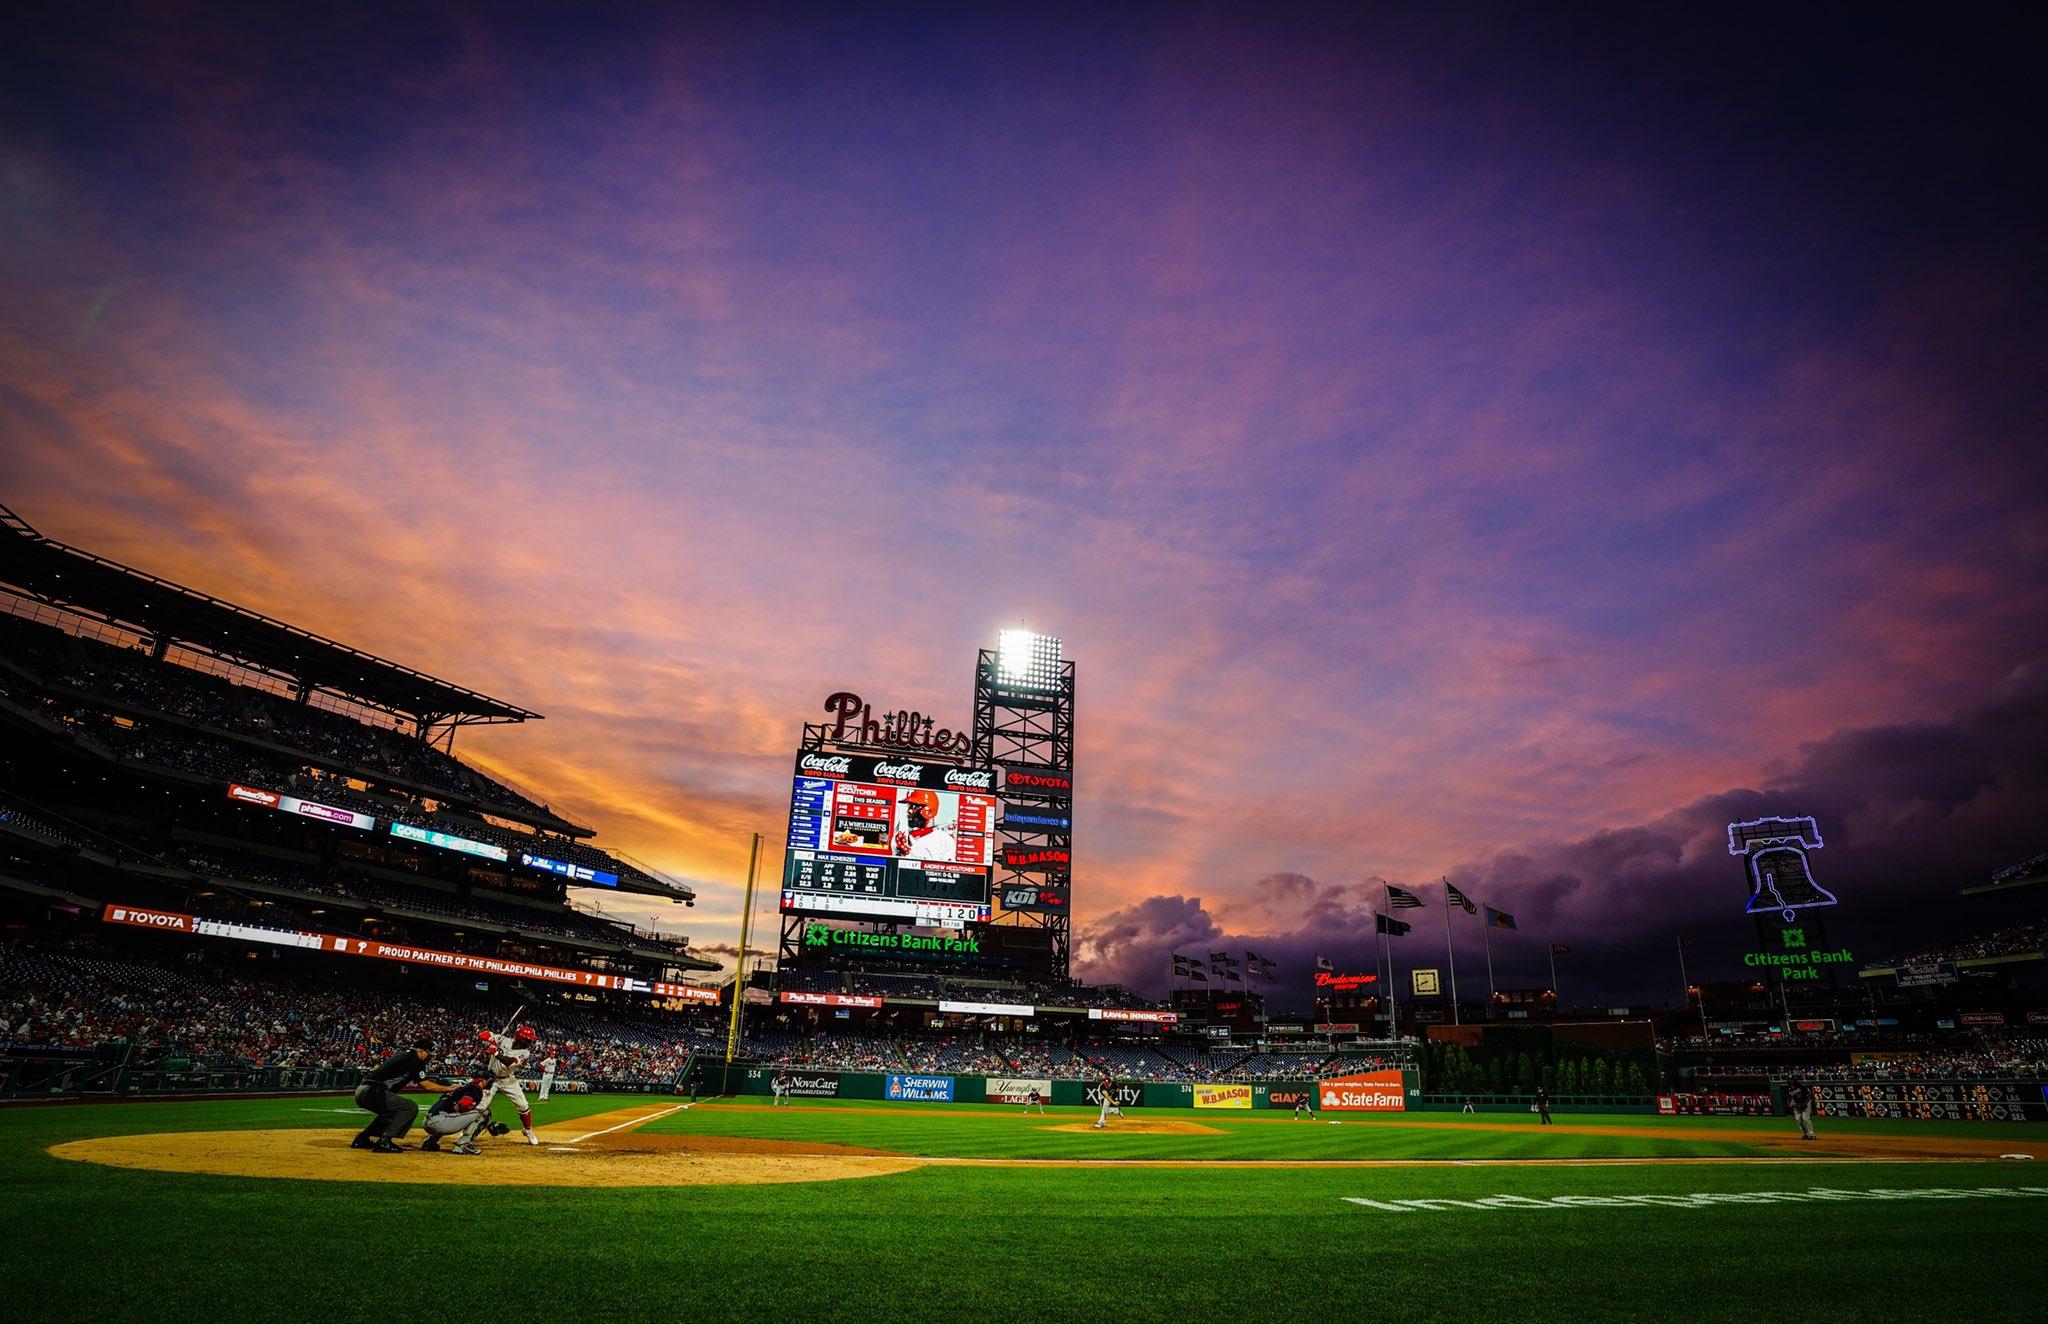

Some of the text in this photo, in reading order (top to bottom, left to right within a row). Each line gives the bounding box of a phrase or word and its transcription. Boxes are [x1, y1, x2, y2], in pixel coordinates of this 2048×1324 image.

[825, 692, 972, 756] Phillies
[1023, 775, 1070, 788] TOYOTA
[300, 803, 352, 823] phillies.com
[1004, 812, 1060, 826] Independence
[397, 824, 426, 840] GOYA
[830, 855, 856, 863] SCHERZER
[1007, 851, 1069, 866] W.B.MASON
[128, 910, 185, 928] TOYOTA
[947, 908, 976, 919] 1 2 0
[832, 929, 980, 953] Citizens Bank Park
[377, 945, 577, 982] PROUD PARTNER OF THE PHILADELPHIA PHILLIES
[1744, 949, 1854, 967] Citizens Bank
[1782, 965, 1820, 980] Park
[1314, 972, 1377, 987] Budweiser
[692, 990, 717, 1000] TOYOTA
[789, 992, 826, 1004] Pep Boys
[838, 995, 875, 1007] Pep Boys
[1216, 1002, 1241, 1010] GIANT
[1129, 1012, 1158, 1021] INNING
[790, 1077, 839, 1089] NovaCare
[903, 1076, 949, 1088] SHERWIN
[994, 1079, 1041, 1094] Yuenglig
[790, 1088, 836, 1096] REHABILITATION
[902, 1088, 950, 1100] WILLAMS.
[1201, 1088, 1250, 1104] W.B.MASON
[1409, 1089, 1420, 1097] 409
[2006, 1094, 2021, 1102] LAA
[2008, 1104, 2024, 1112] COL
[2011, 1113, 2026, 1121] SEA
[1339, 1186, 2048, 1213] Independenc
